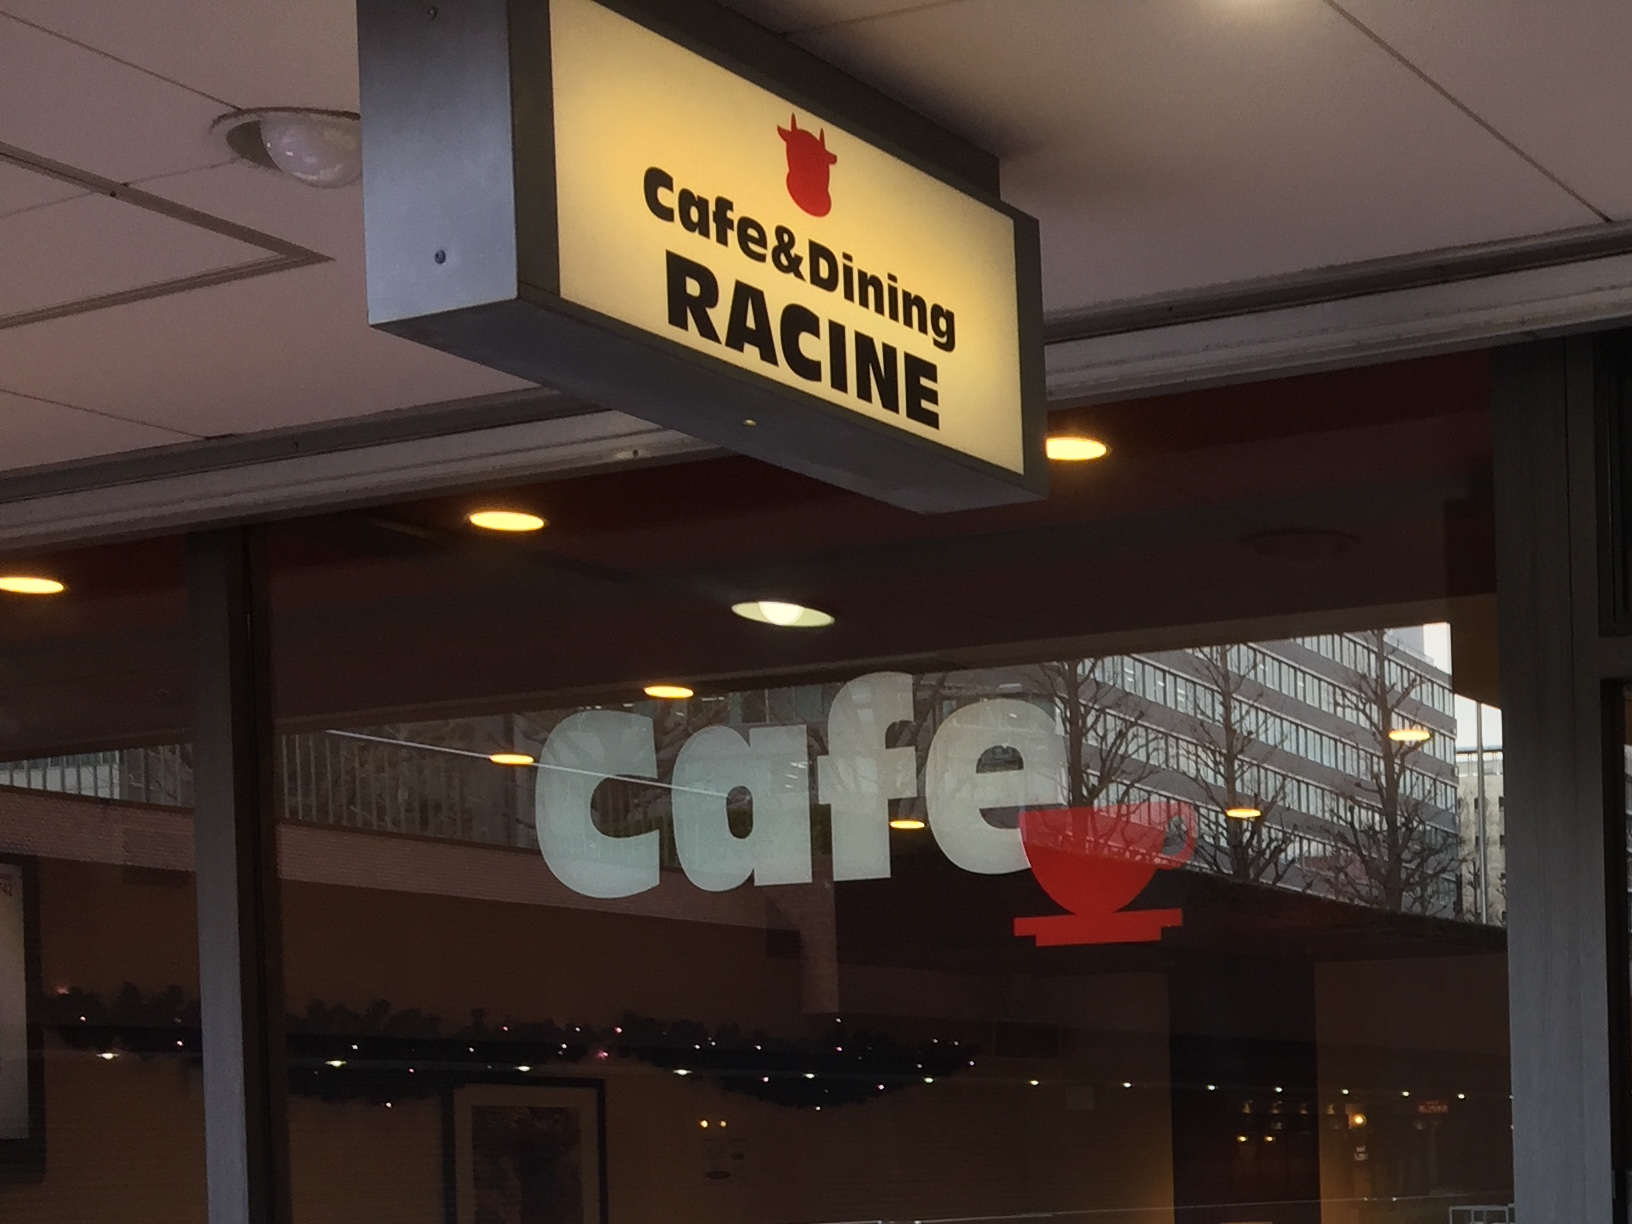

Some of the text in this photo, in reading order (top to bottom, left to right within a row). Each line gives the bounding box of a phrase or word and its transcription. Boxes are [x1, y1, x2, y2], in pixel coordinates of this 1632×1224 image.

[643, 166, 956, 352] Cafe&Dining
[666, 250, 940, 430] RACINE
[535, 671, 1069, 899] Cafe
